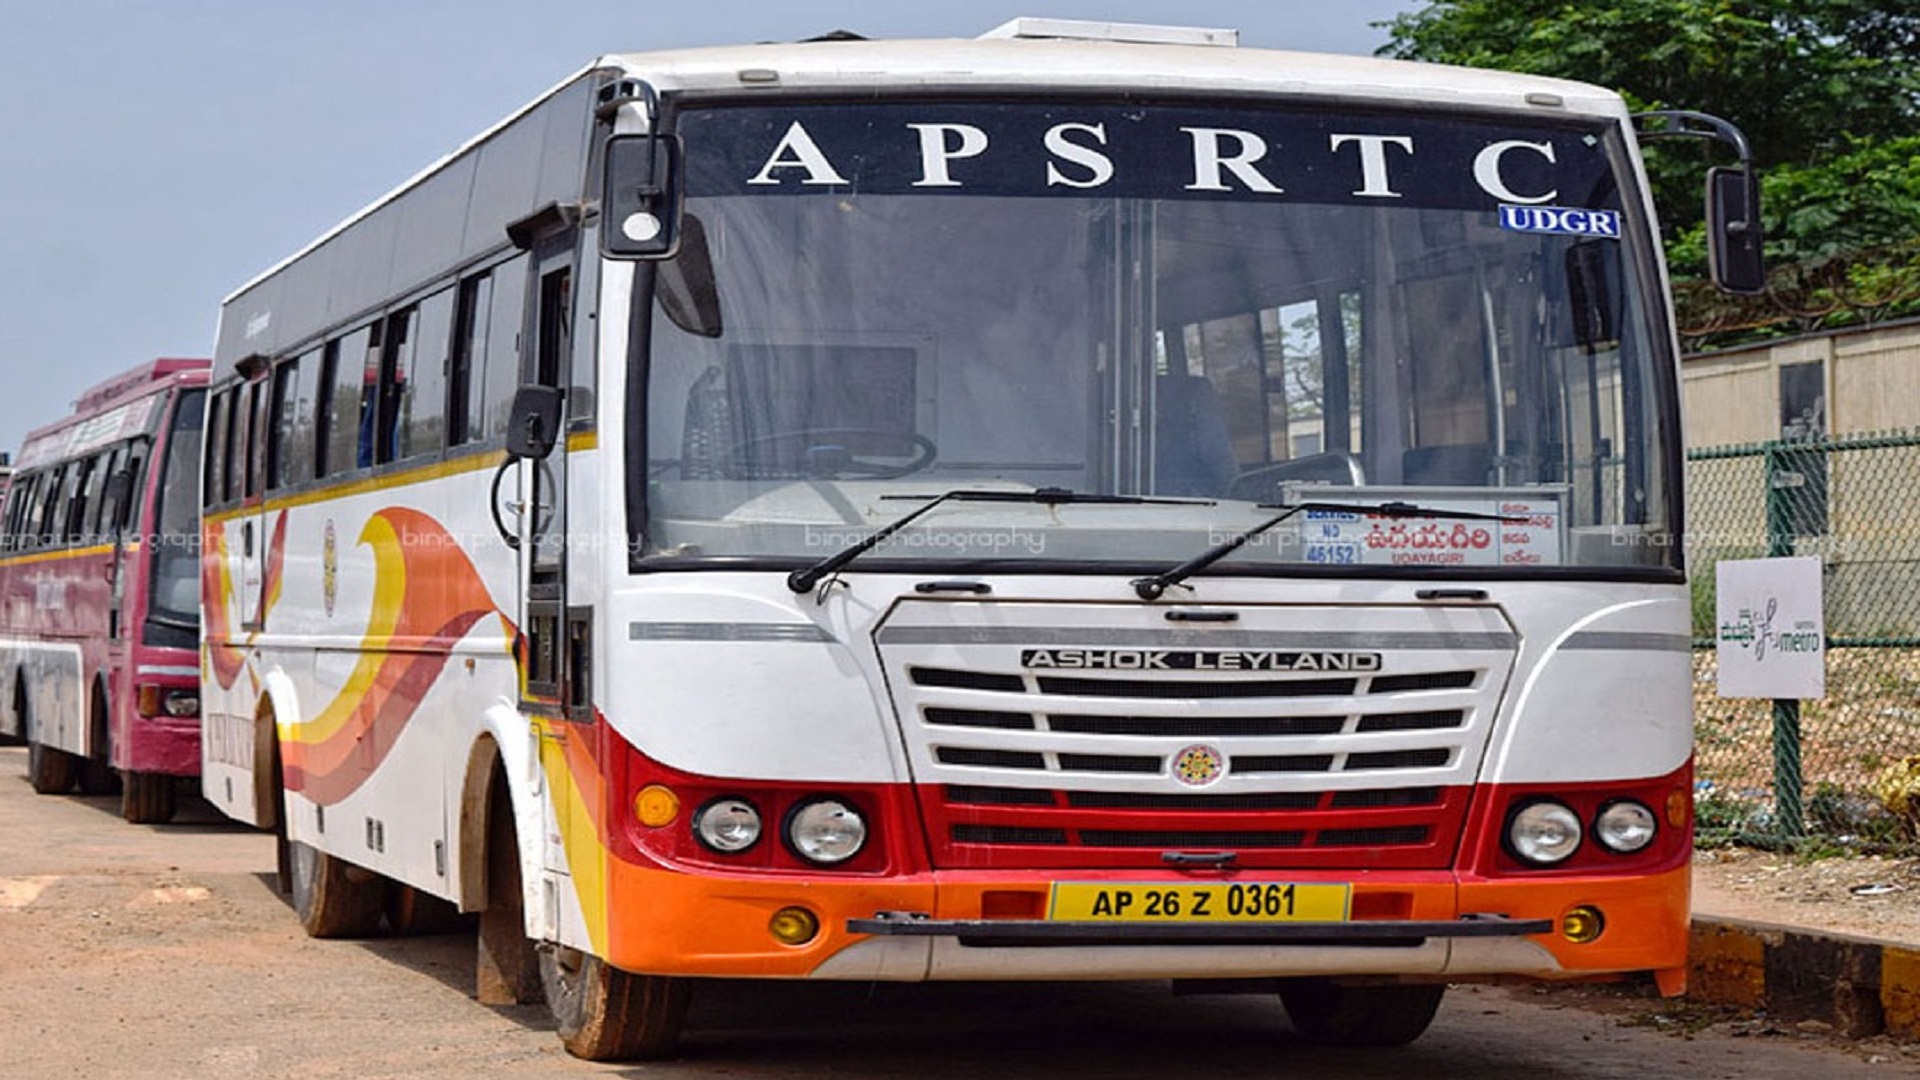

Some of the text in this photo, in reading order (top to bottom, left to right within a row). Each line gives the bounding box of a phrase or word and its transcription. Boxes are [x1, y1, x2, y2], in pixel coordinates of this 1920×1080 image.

[1506, 207, 1614, 235] UDGR
[1306, 544, 1354, 563] 46152
[1391, 552, 1466, 564] UDAYAGIRI
[1779, 631, 1820, 652] metro
[1027, 650, 1380, 671] ASHOK LEYLAND
[1091, 883, 1296, 916] AP 26 Z 0361
